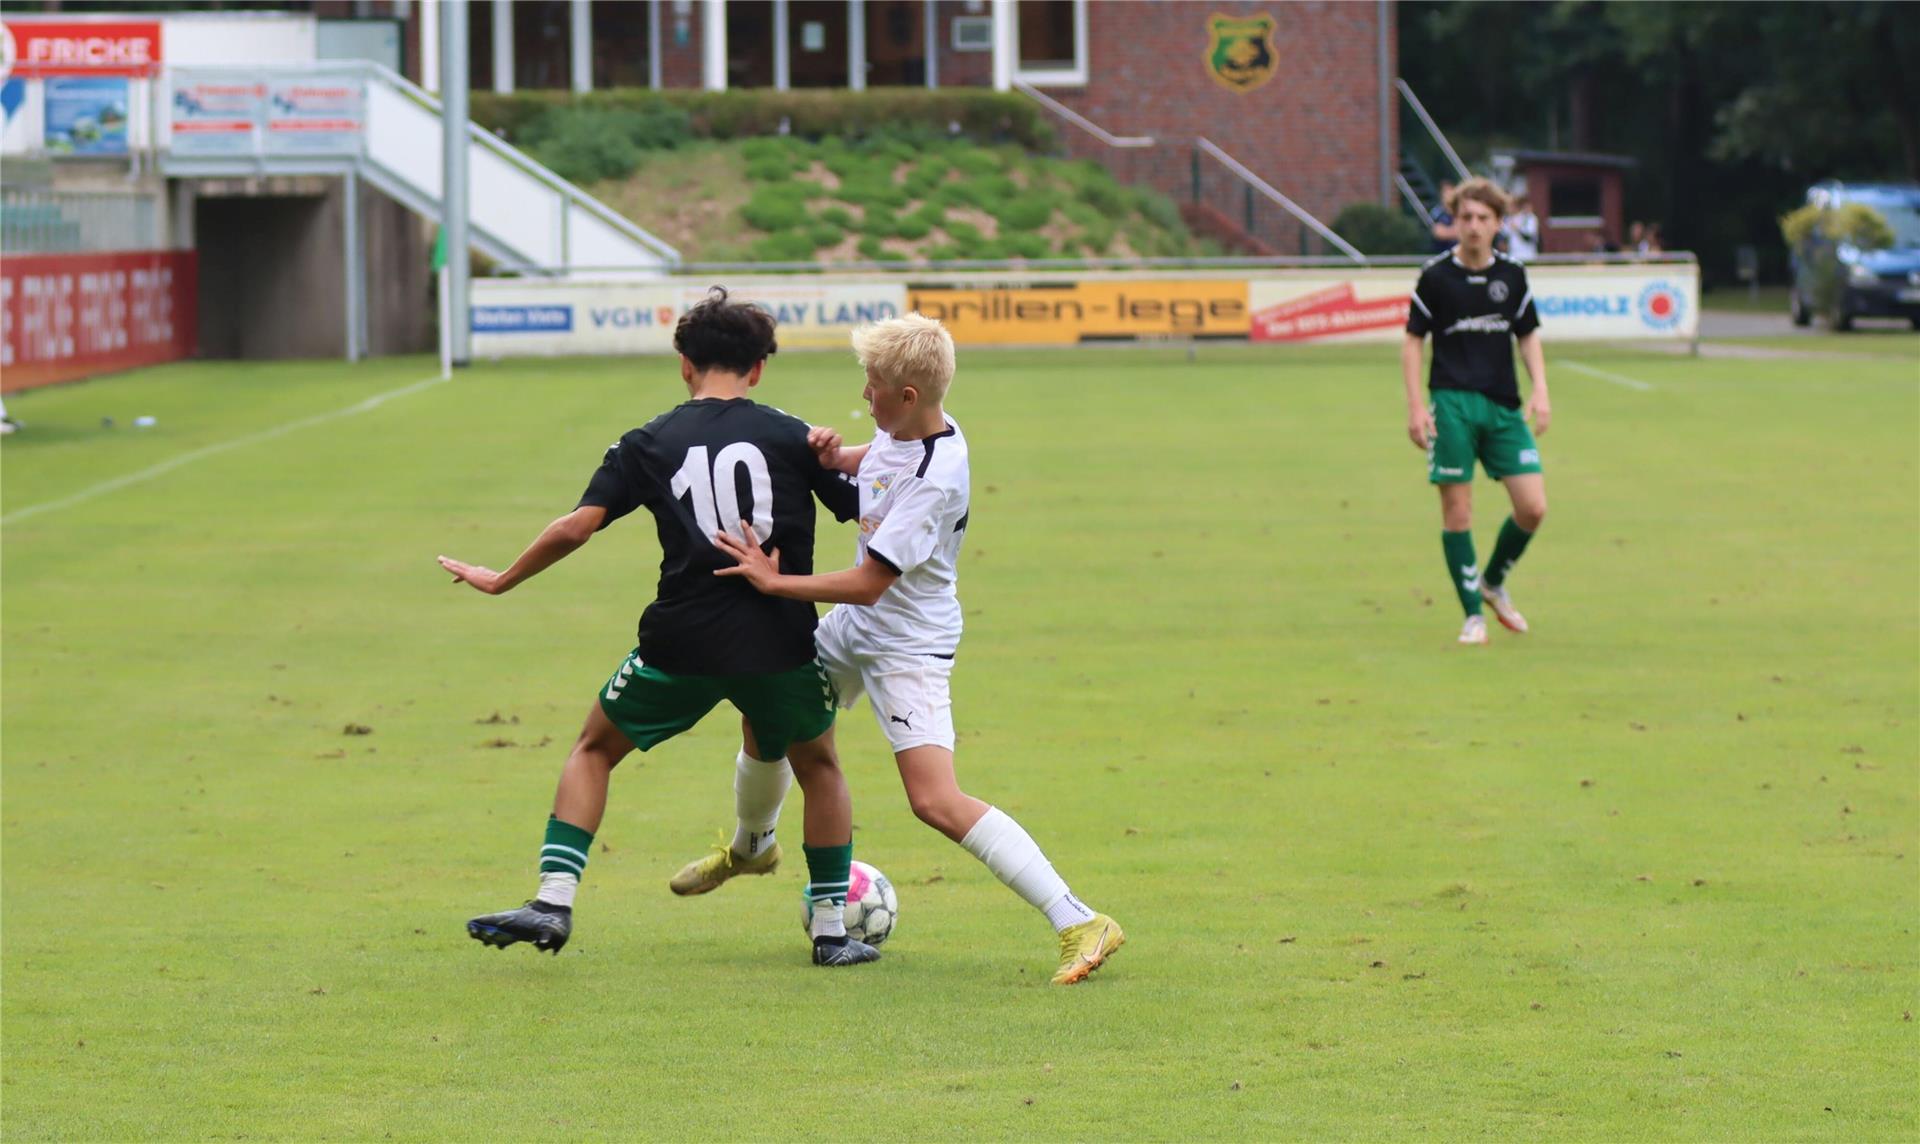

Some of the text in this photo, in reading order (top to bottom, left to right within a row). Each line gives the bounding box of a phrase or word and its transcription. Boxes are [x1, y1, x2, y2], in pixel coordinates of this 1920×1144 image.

[28, 37, 151, 66] FRICKE
[590, 304, 653, 328] VGH
[816, 301, 897, 325] LAND
[670, 441, 774, 547] 10
